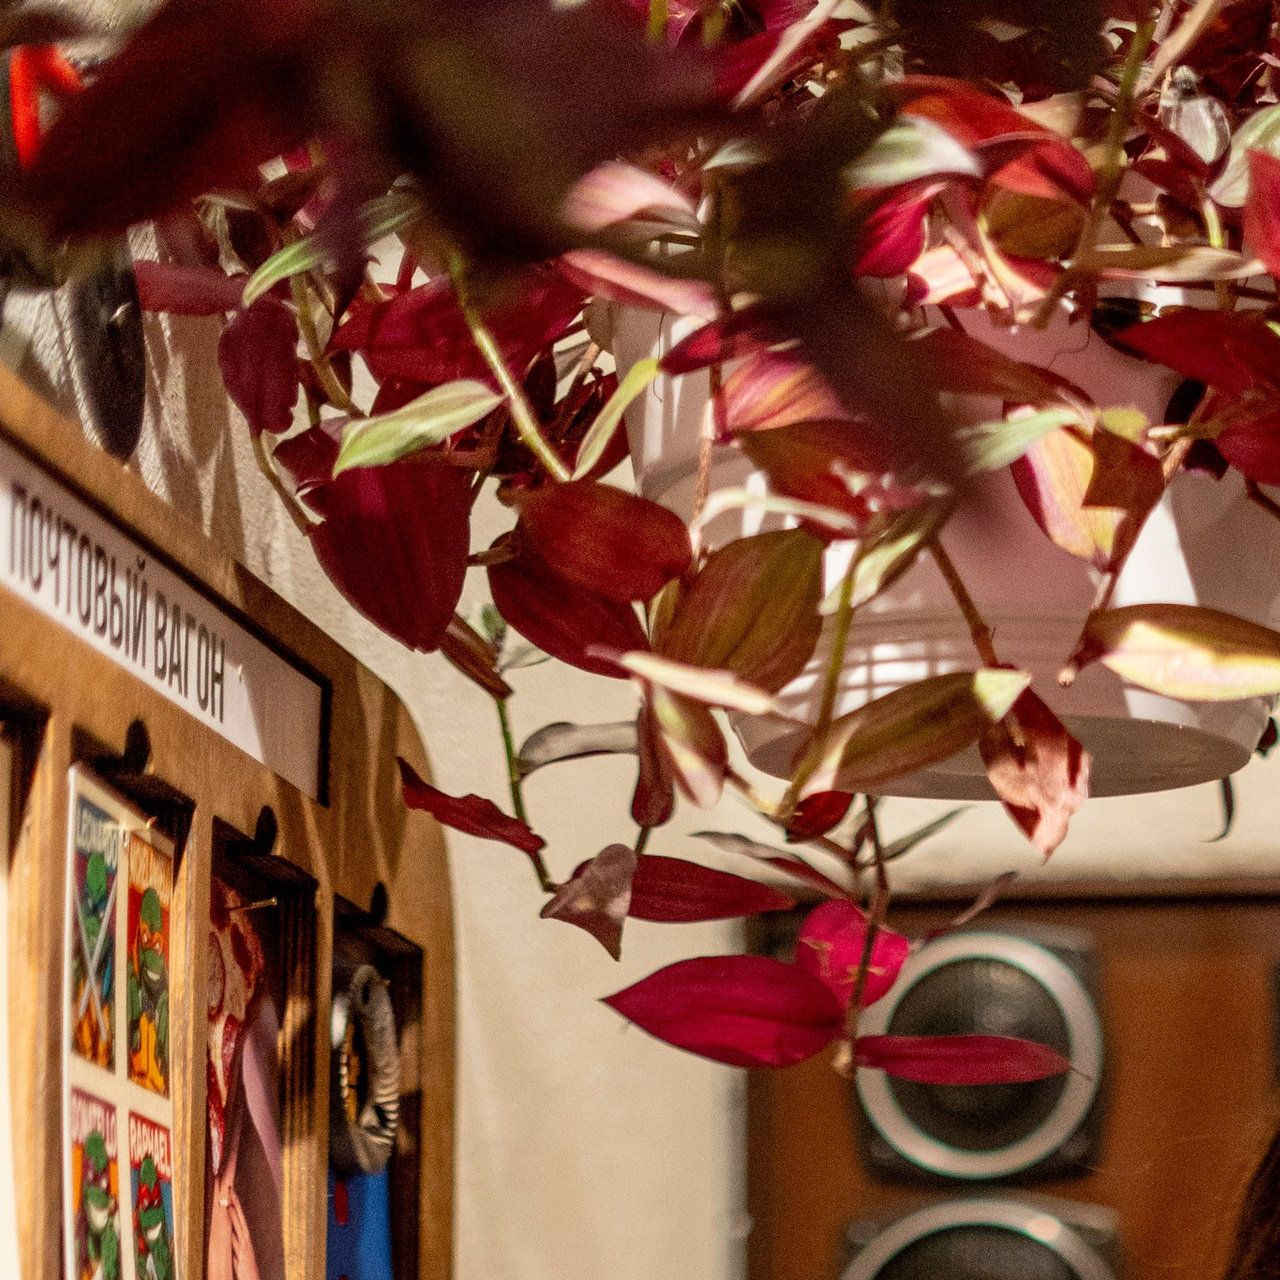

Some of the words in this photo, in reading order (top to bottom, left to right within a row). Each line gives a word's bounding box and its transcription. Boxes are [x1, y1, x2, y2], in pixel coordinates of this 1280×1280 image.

[9, 482, 148, 668] ПОЧТОВЫЙ
[154, 593, 226, 723] ВАГОН
[129, 1113, 172, 1181] RAPHAEL
